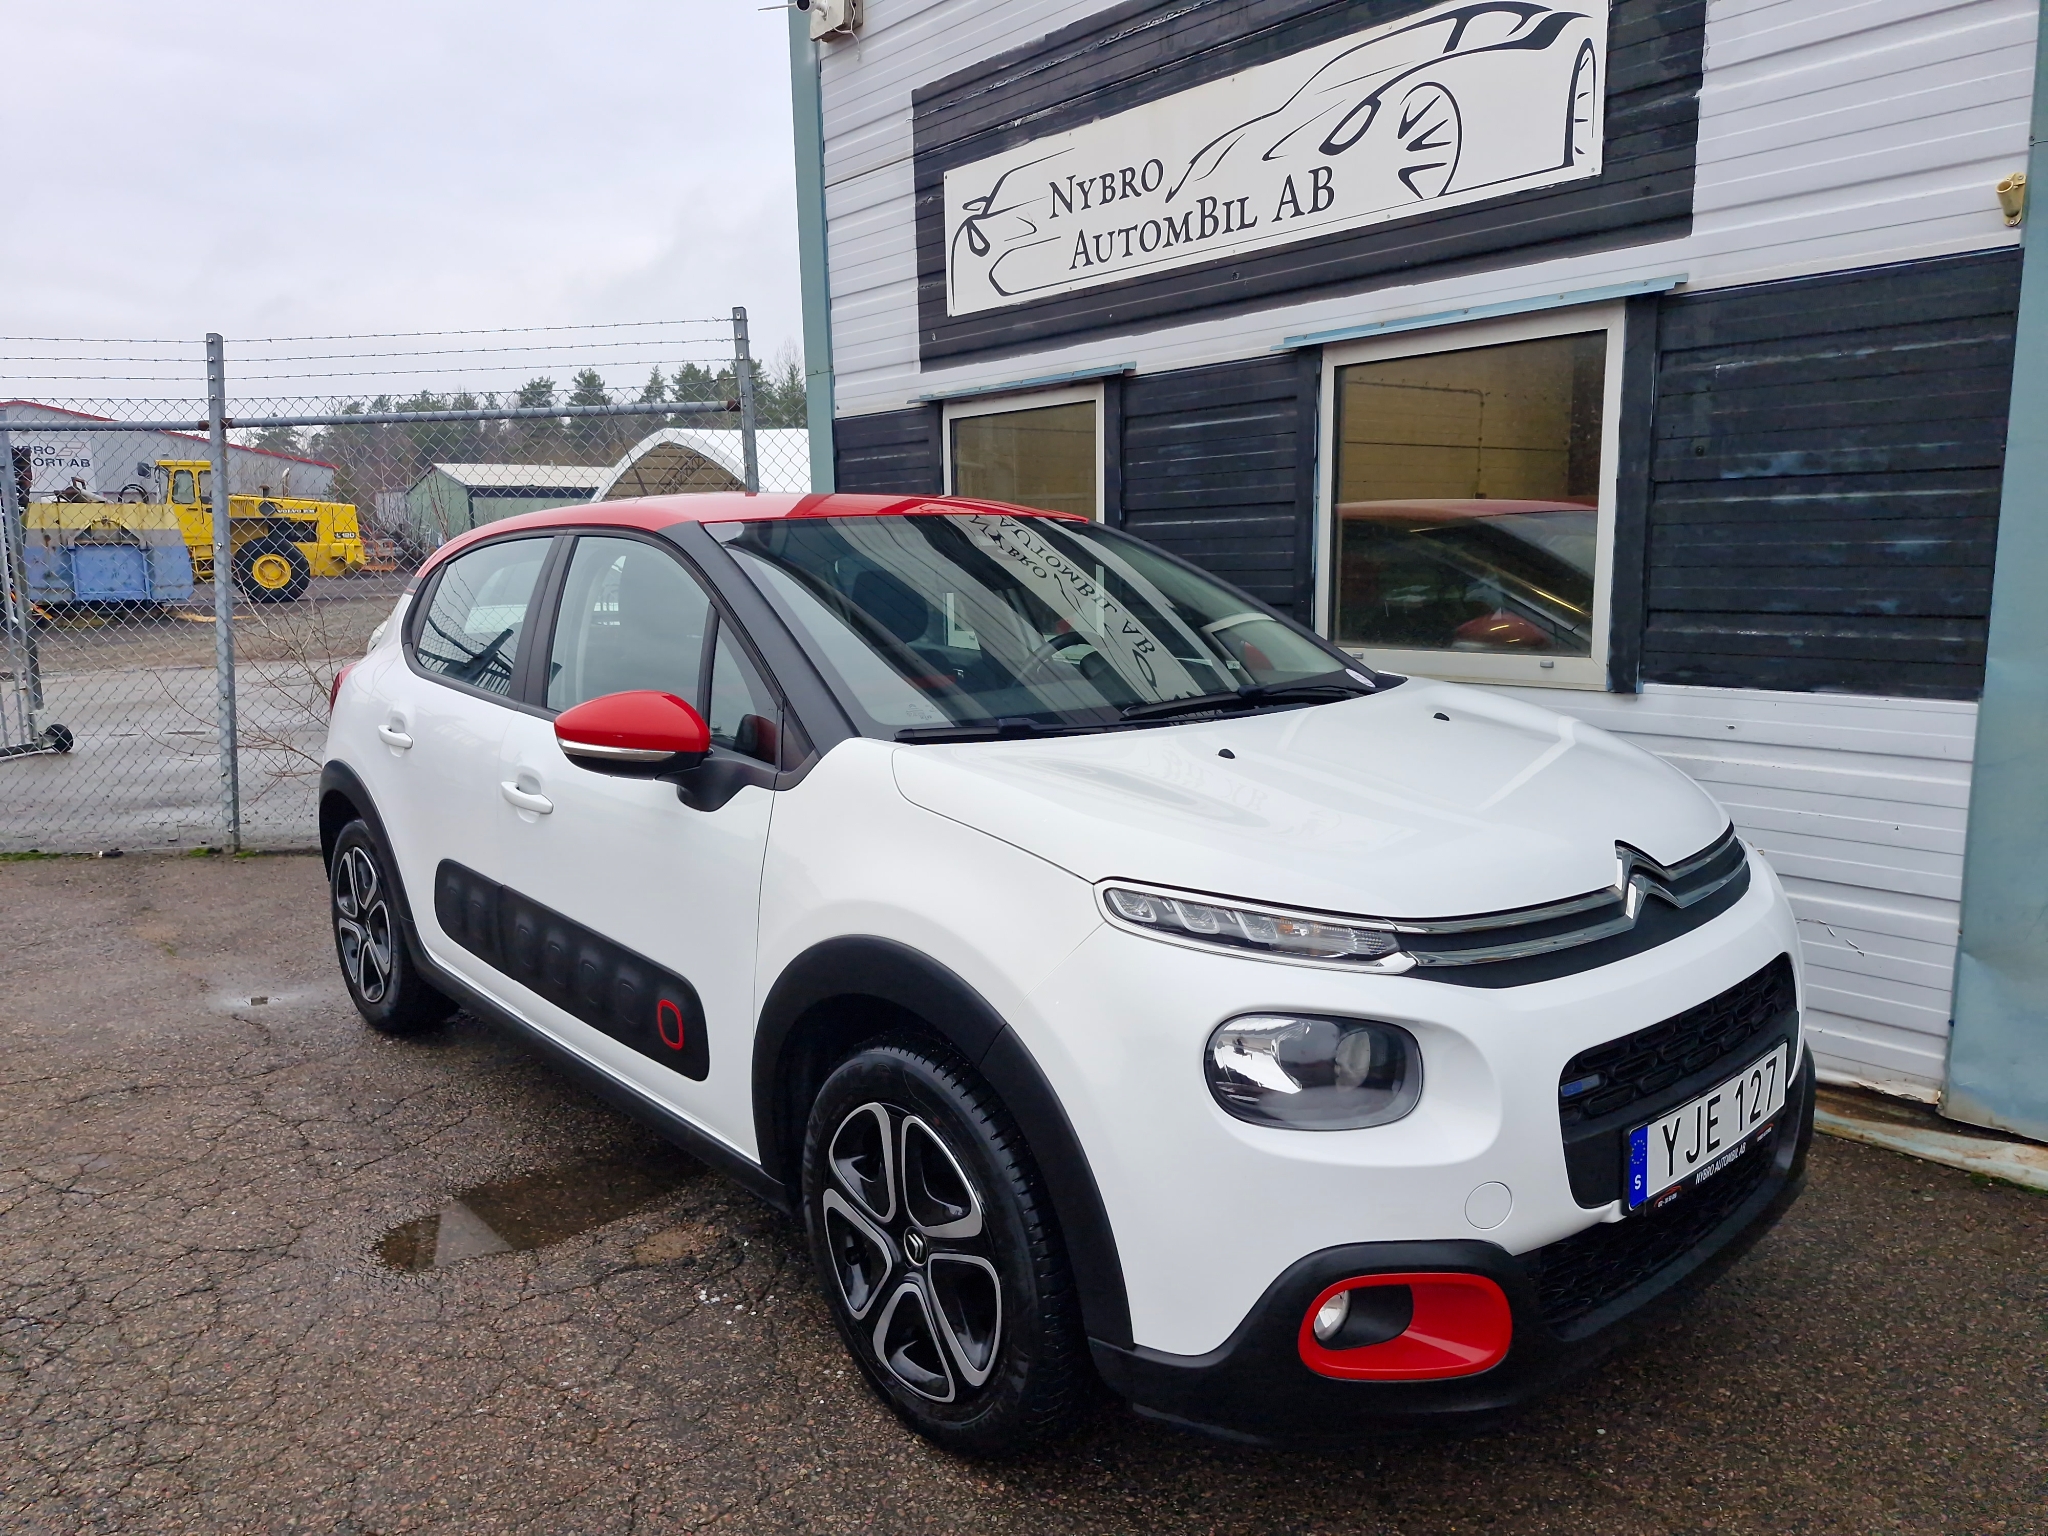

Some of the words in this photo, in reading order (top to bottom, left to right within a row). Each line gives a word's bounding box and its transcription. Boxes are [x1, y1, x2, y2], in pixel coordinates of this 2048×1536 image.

[1049, 158, 1164, 219] NYBRO
[1271, 165, 1335, 223] AB
[70, 458, 91, 468] AB
[1662, 1094, 1720, 1178] YJE
[1735, 1056, 1777, 1132] 127
[1634, 1174, 1642, 1190] S
[1695, 1165, 1715, 1185] NYBRO
[1739, 1142, 1747, 1156] AB
